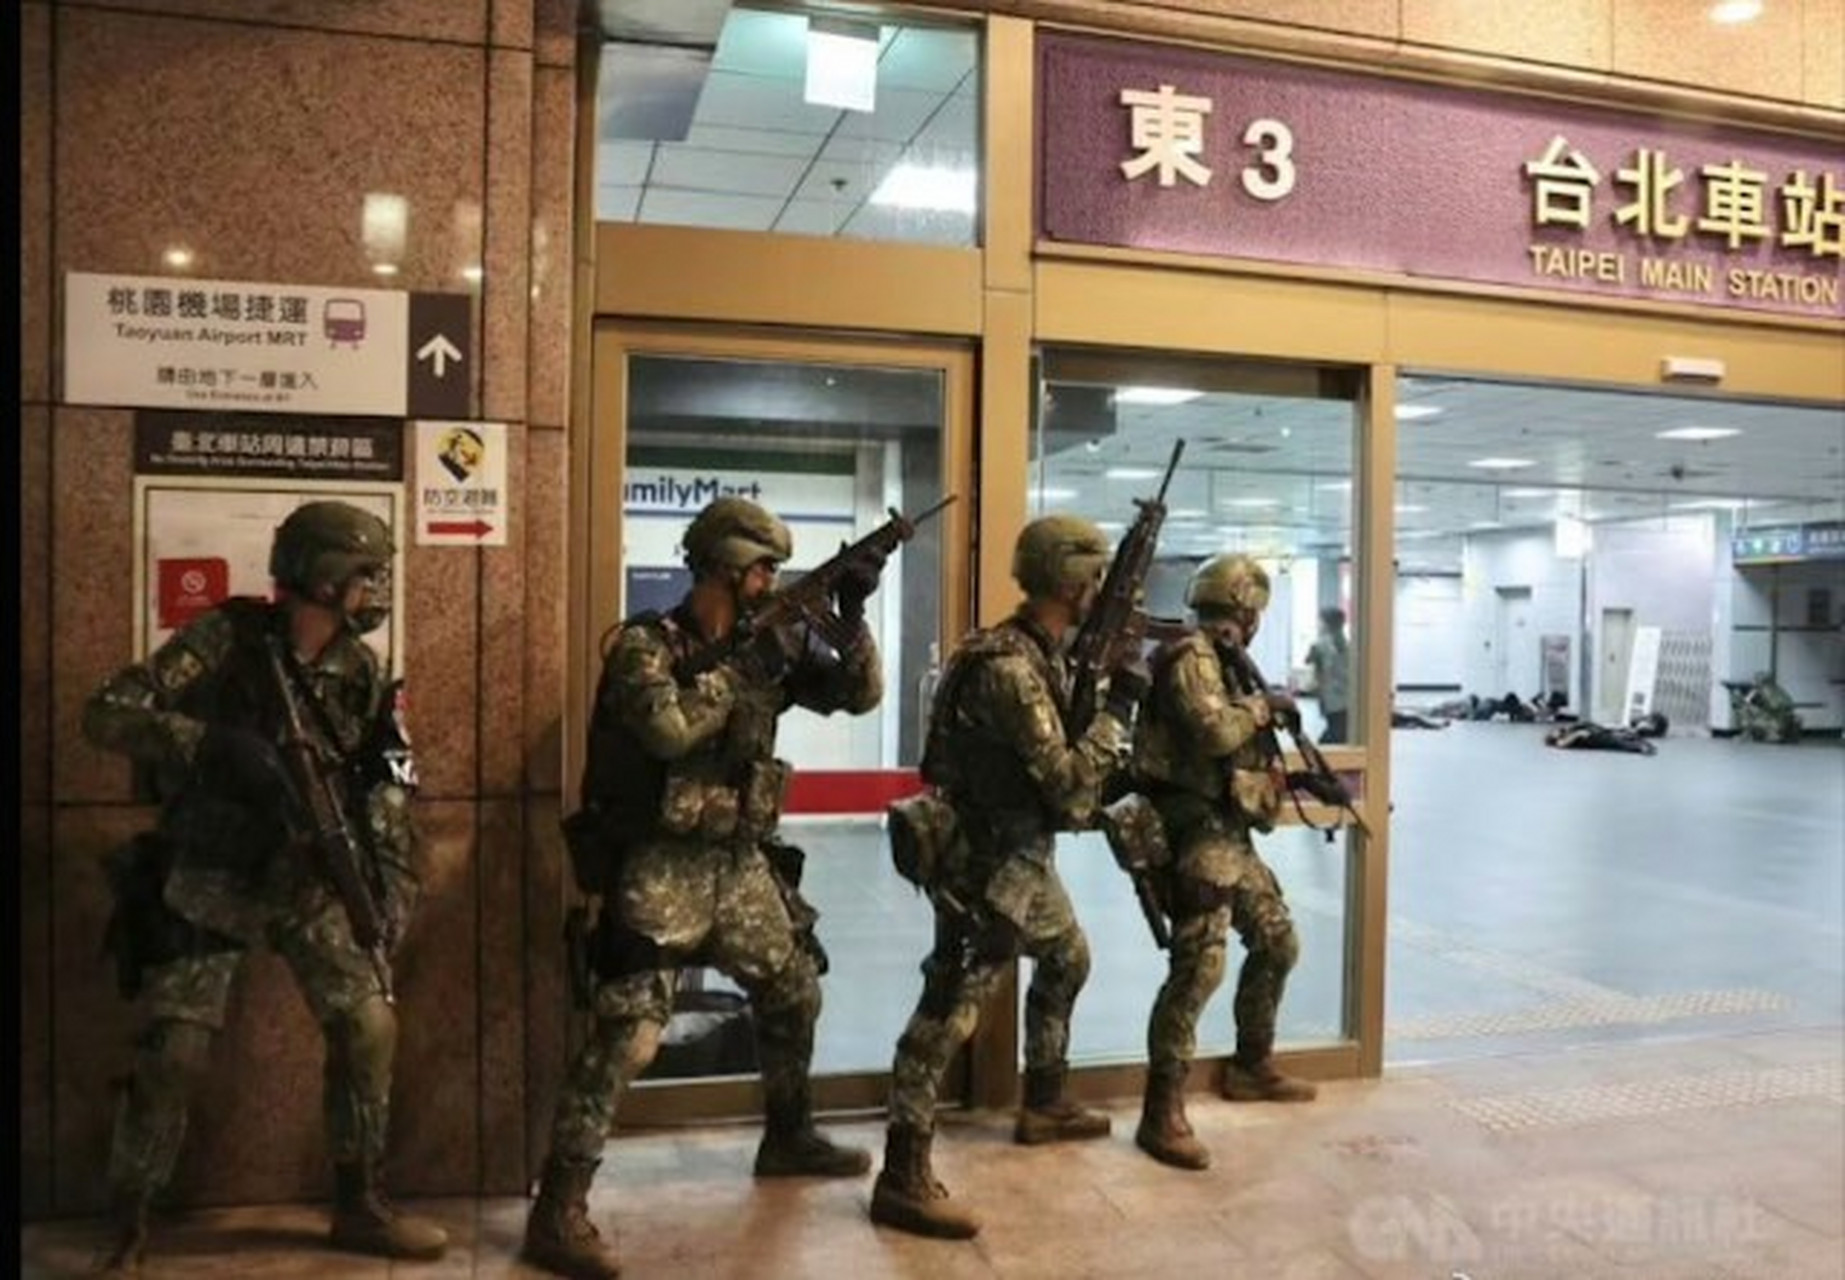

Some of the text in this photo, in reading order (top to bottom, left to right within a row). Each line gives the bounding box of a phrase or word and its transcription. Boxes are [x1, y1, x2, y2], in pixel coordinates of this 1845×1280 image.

[1120, 84, 1296, 200] 東 3
[1525, 136, 1845, 257] 台北車站
[1530, 246, 1838, 303] TAIPEI MAIN STATION
[107, 286, 308, 325] 桃園機場捷運
[115, 322, 307, 346] Taoyuan Airport MRT
